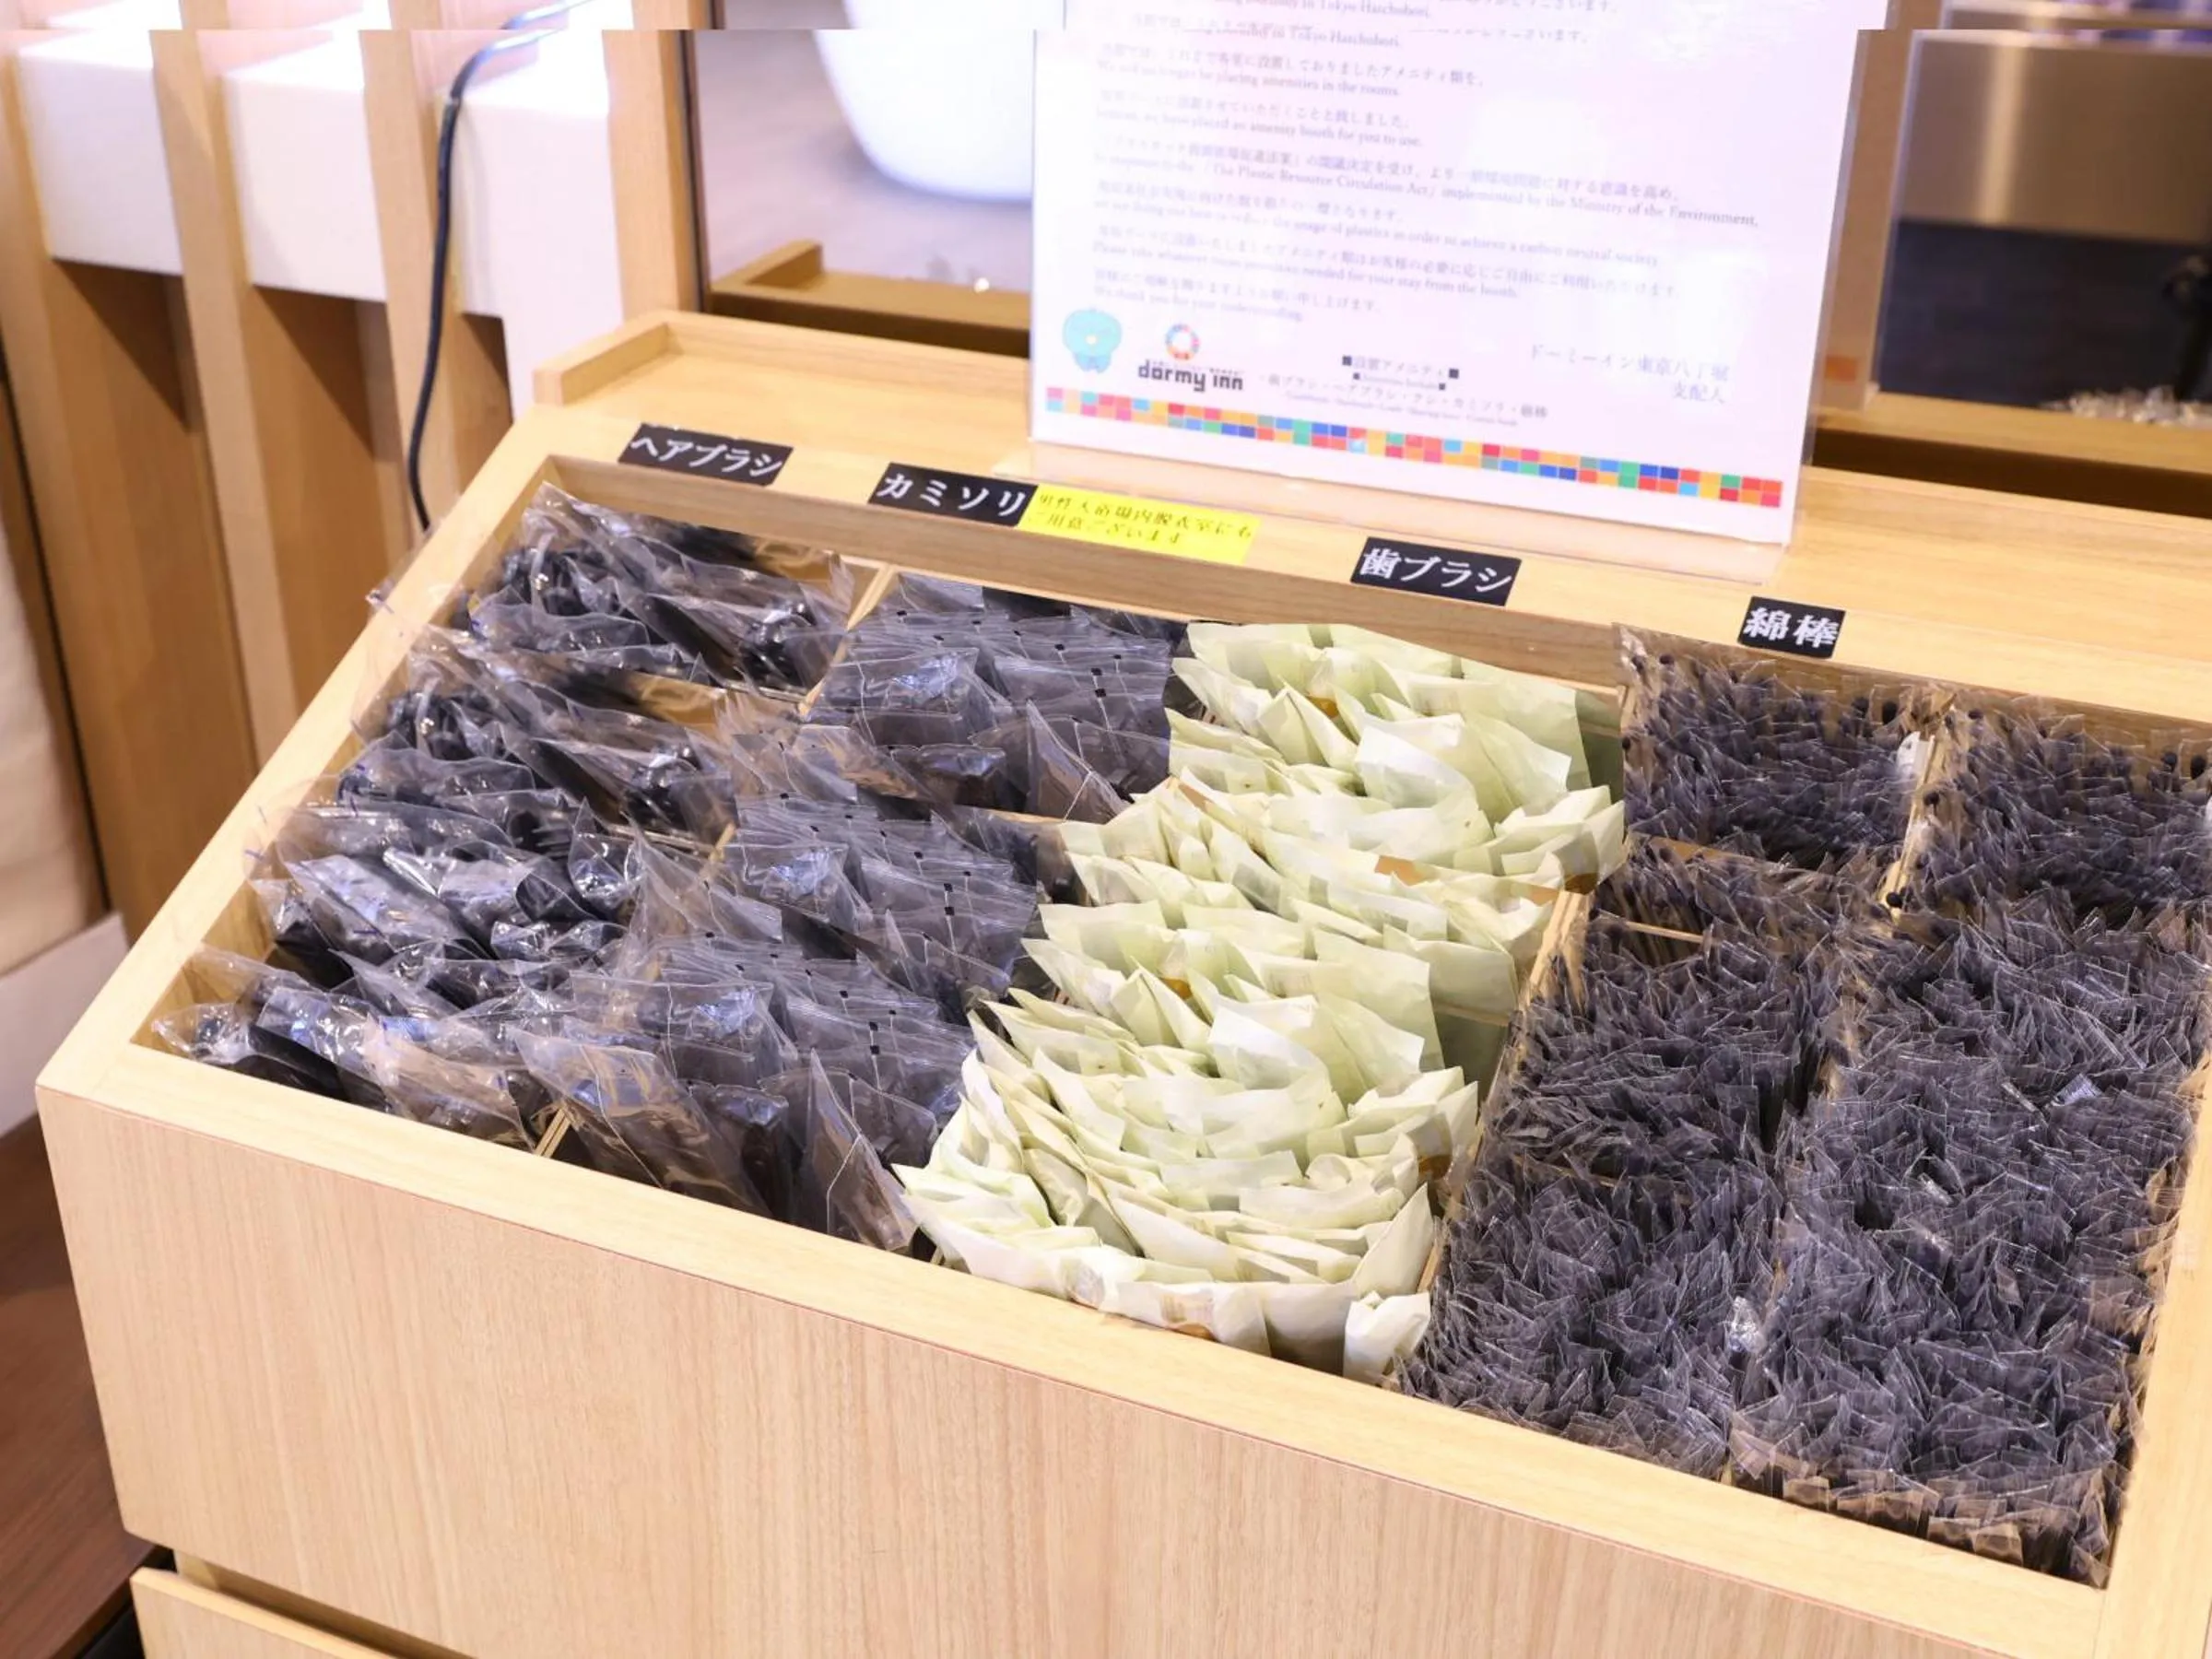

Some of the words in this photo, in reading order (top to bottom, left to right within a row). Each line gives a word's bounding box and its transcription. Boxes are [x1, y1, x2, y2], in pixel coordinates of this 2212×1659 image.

[1138, 359, 1206, 393] dormy
[1213, 374, 1243, 391] inn
[630, 435, 785, 478] ヘアブラシ
[877, 474, 1025, 516] カミソリ
[1360, 547, 1512, 594] 歯ブラシ
[1745, 606, 1841, 650] 綿棒
